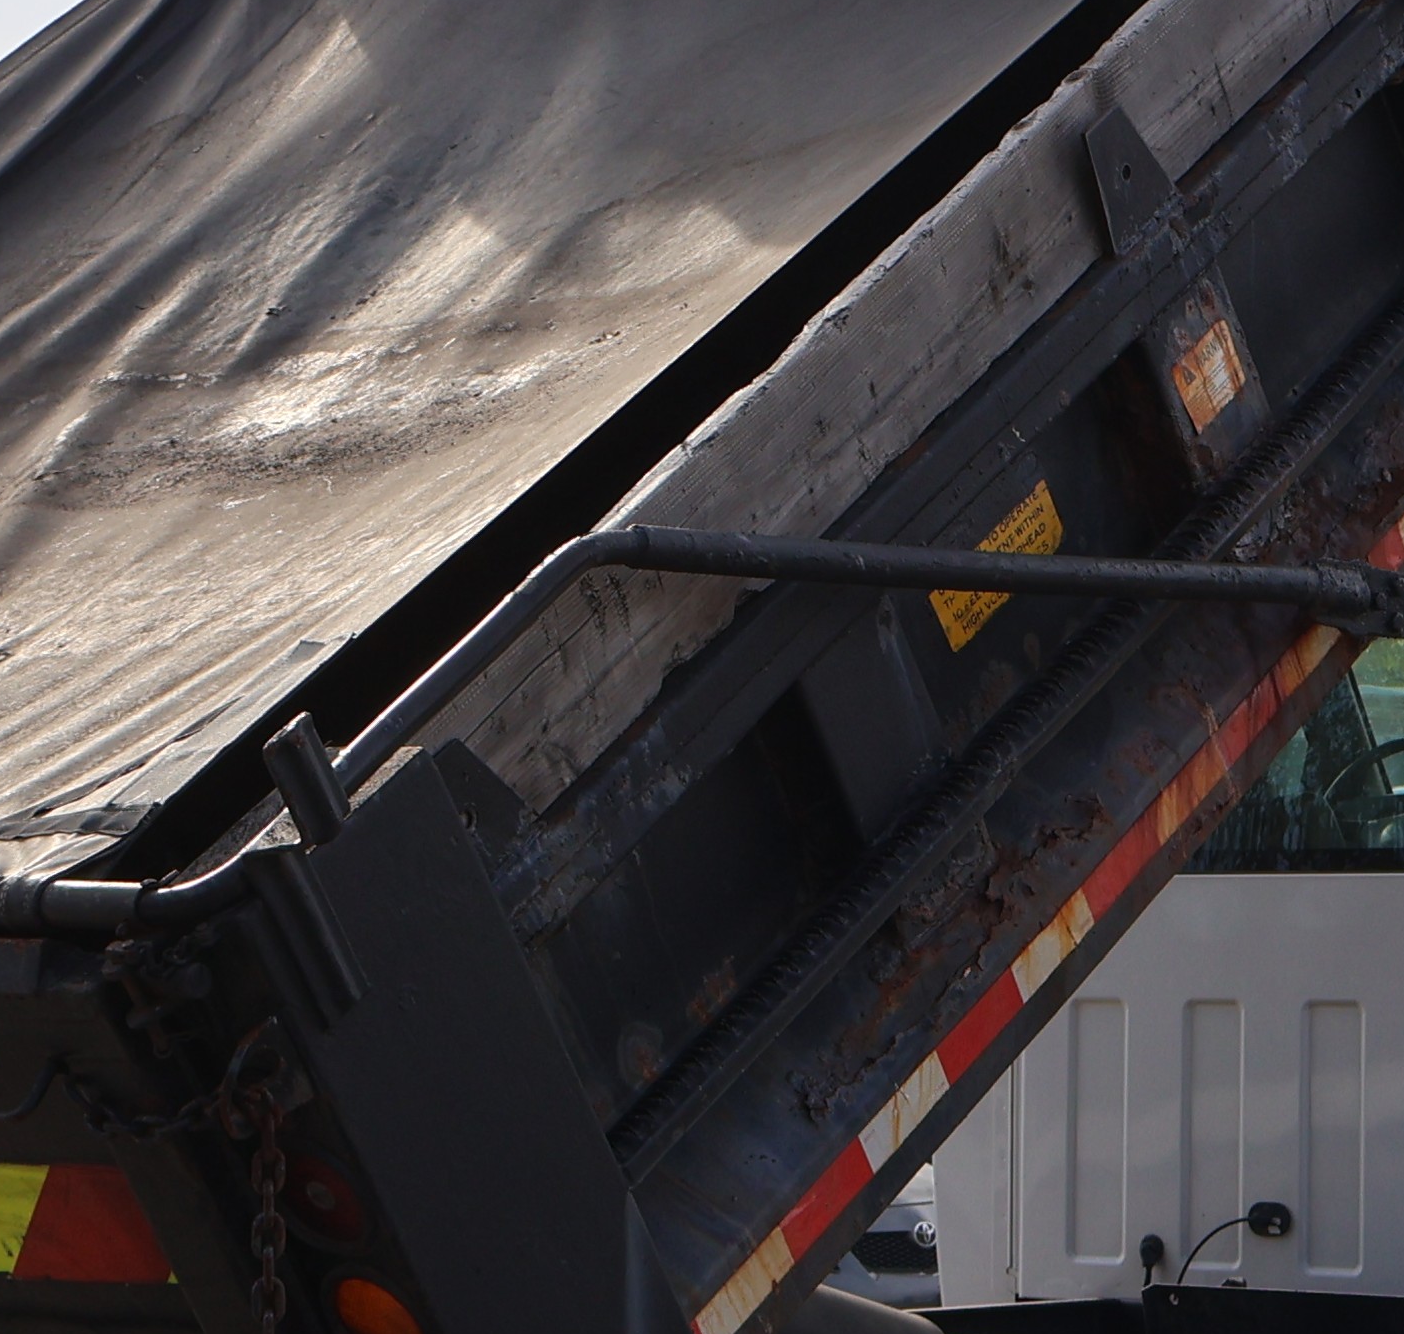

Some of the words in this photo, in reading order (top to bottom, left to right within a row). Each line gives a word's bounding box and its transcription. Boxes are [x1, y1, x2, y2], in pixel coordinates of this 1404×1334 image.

[999, 491, 1039, 533] OPERATE
[1014, 504, 1045, 537] WITHIN
[961, 607, 985, 634] HIGH
